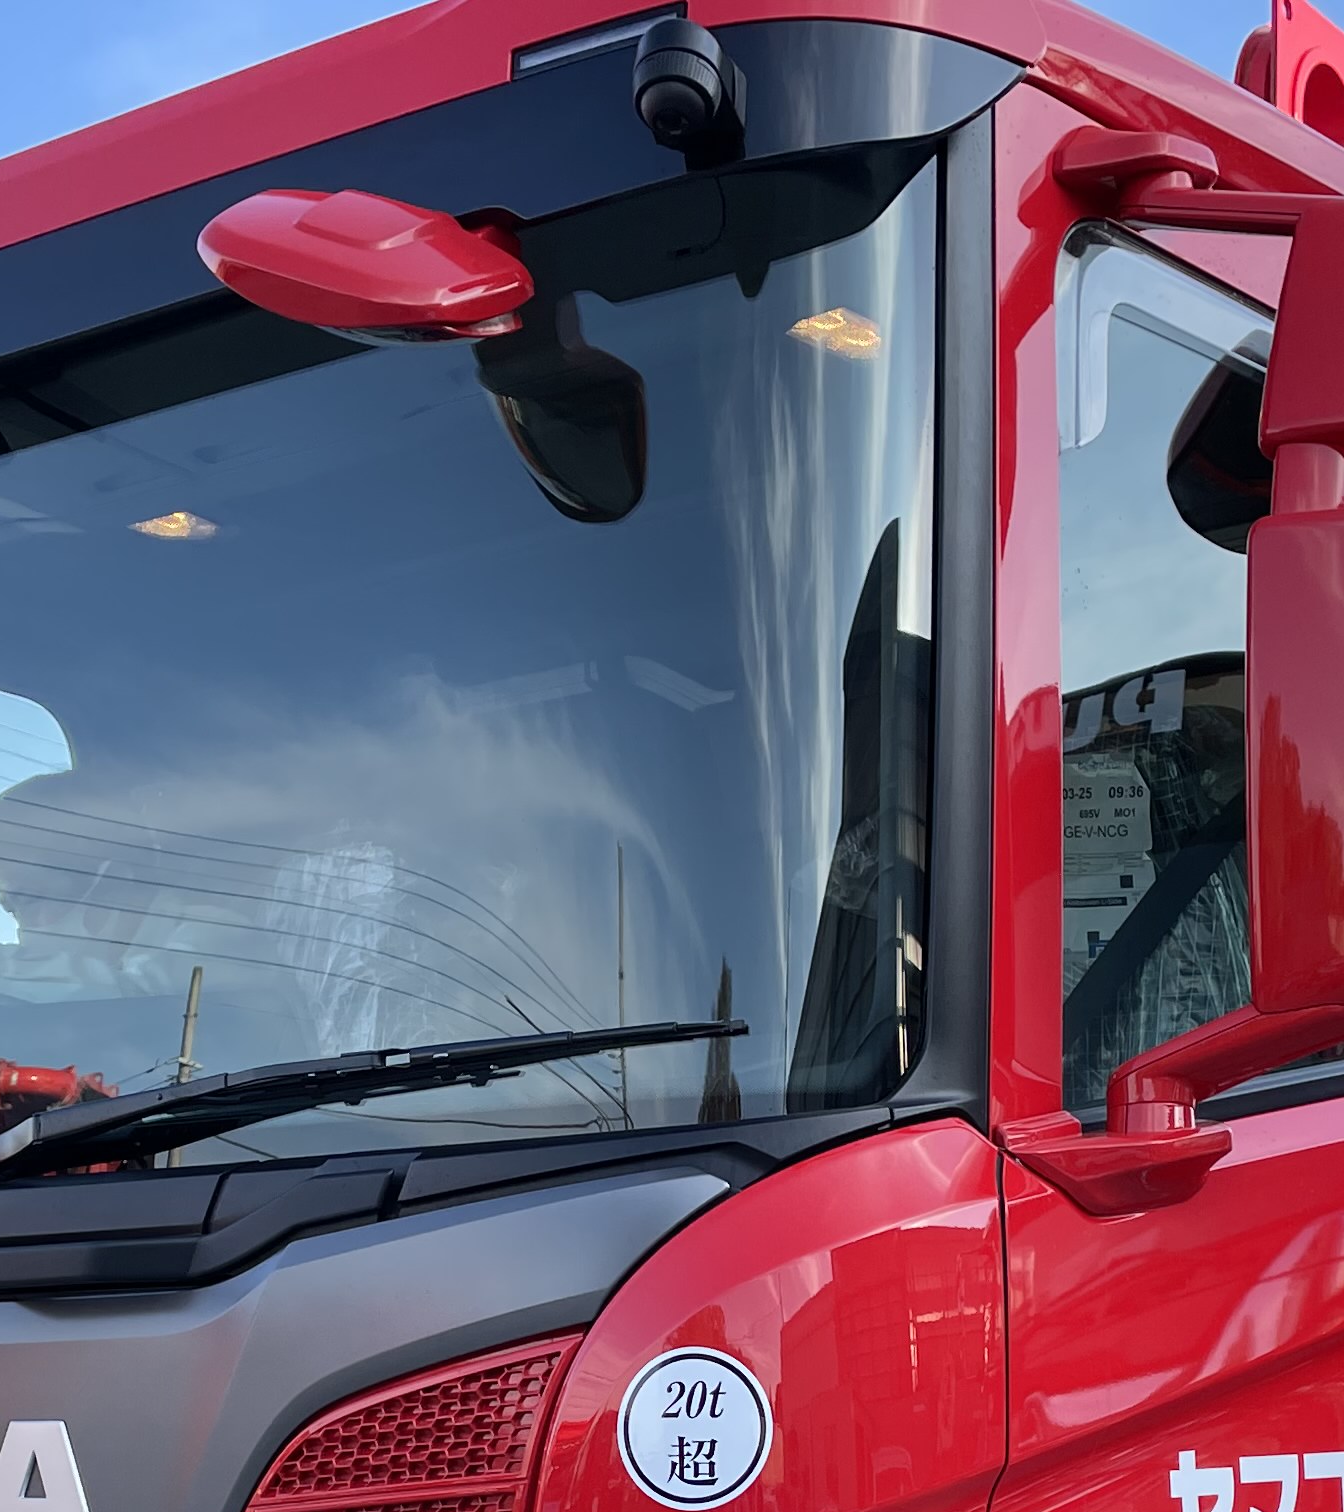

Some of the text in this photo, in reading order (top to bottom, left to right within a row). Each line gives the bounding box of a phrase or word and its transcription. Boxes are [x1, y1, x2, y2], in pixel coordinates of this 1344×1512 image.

[1108, 785, 1144, 799] 09:36
[661, 1380, 727, 1419] 20t
[666, 1436, 719, 1486] 超
